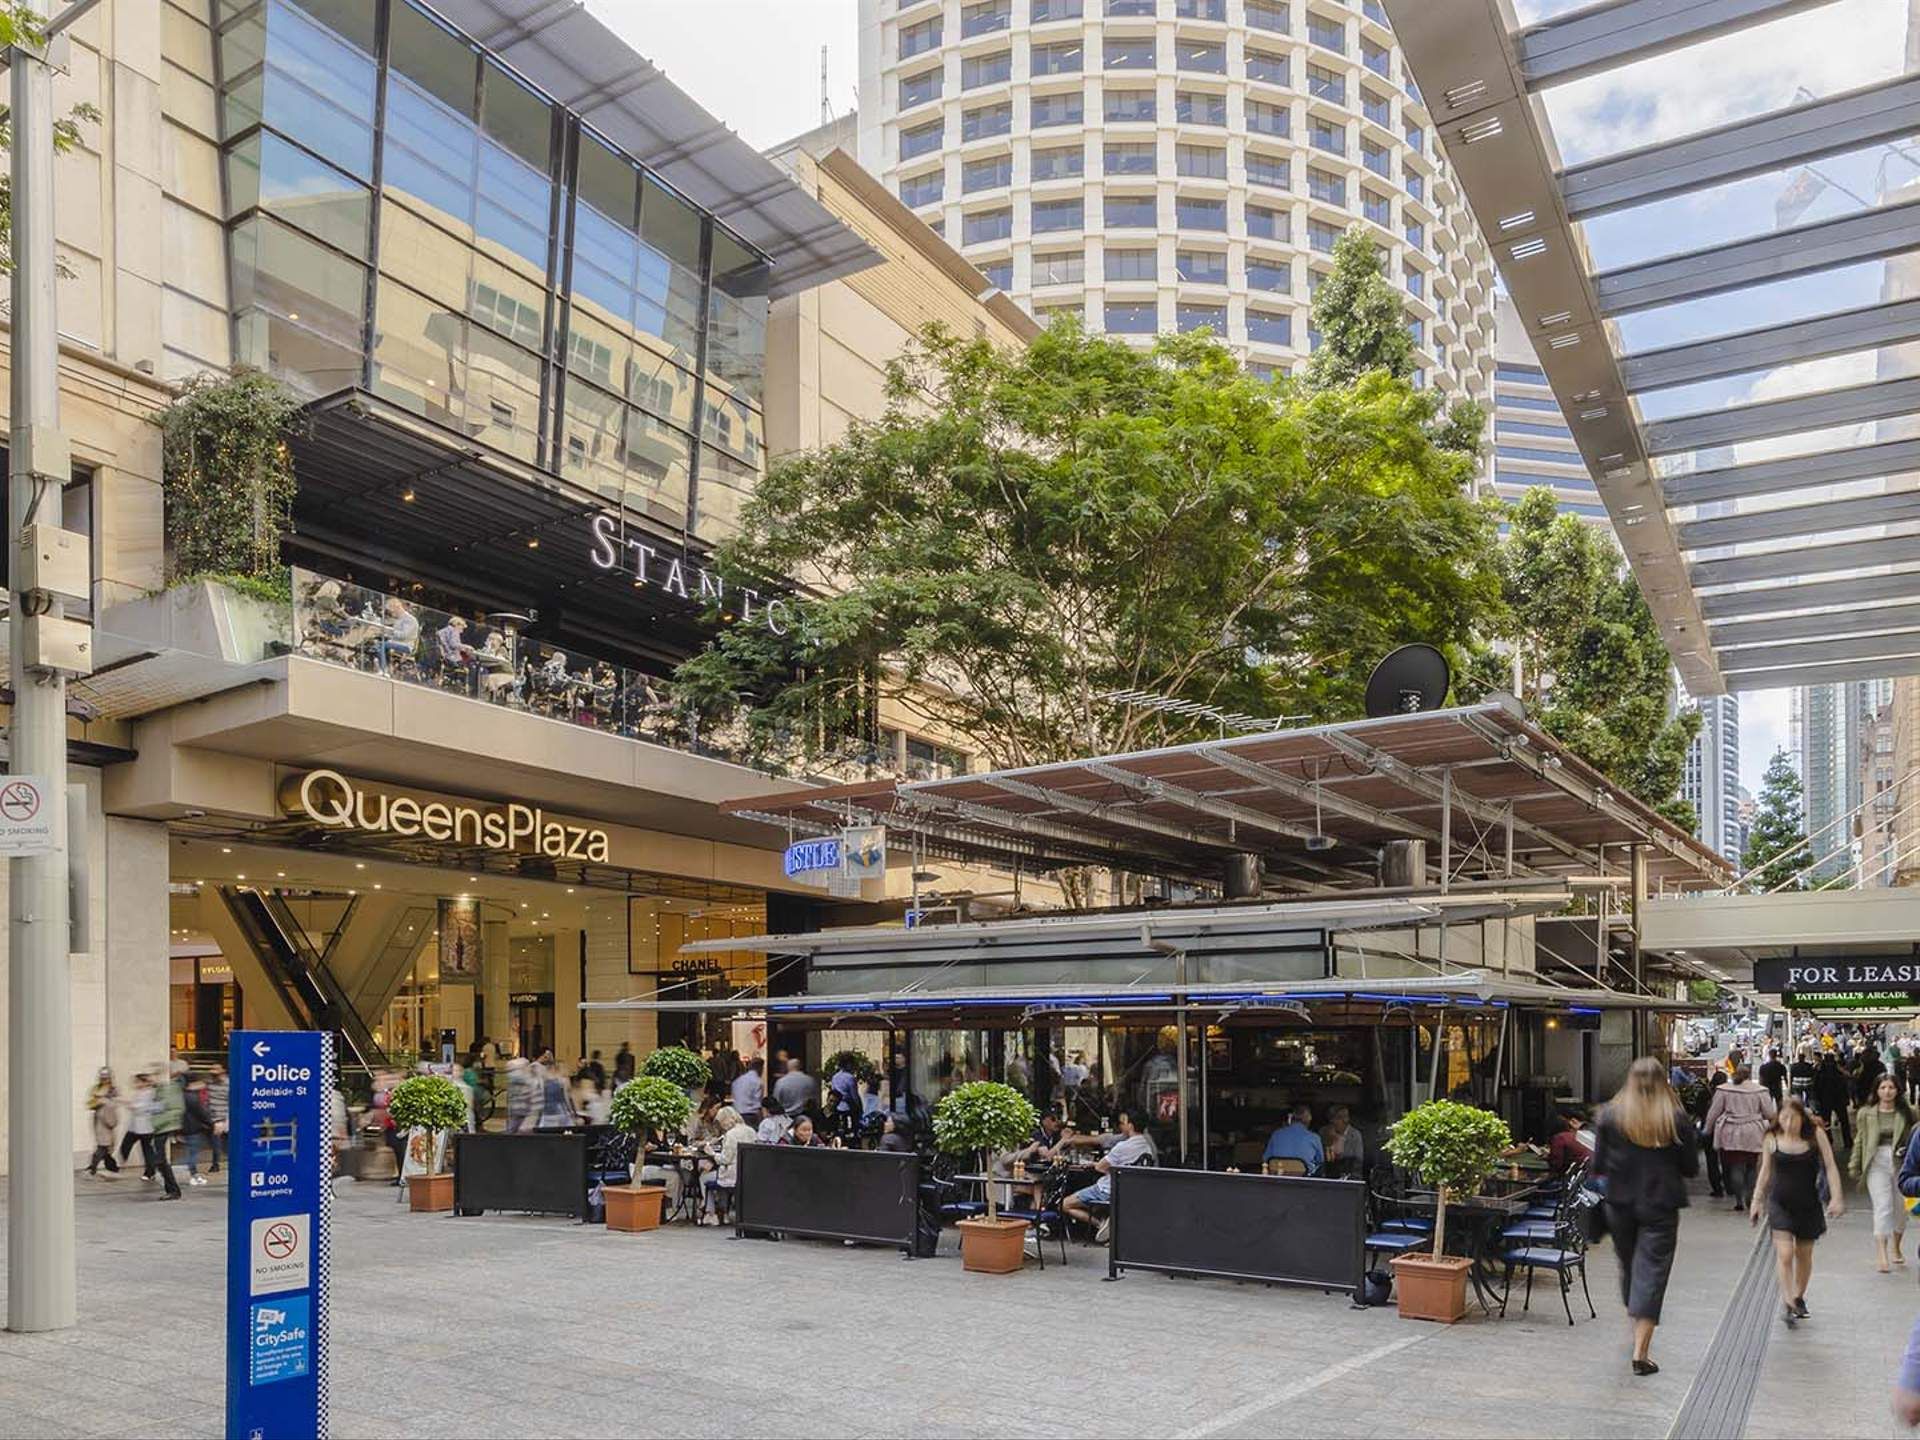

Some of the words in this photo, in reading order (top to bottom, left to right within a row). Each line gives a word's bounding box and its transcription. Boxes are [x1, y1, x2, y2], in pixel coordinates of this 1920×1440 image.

[301, 769, 609, 863] QueensPlaza
[672, 958, 720, 971] CHANEL
[1788, 967, 1839, 984] FOR
[1794, 992, 1864, 1001] TATTERSALL'S
[1868, 991, 1909, 1000] ARCADE
[251, 1064, 311, 1082] Police
[252, 1087, 293, 1097] Adelaide
[296, 1086, 307, 1096] St
[252, 1101, 276, 1110] 300m
[268, 1174, 288, 1185] 000
[251, 1187, 293, 1198] Emergency
[270, 1261, 304, 1273] SMOKING
[256, 1327, 306, 1347] CitySafe
